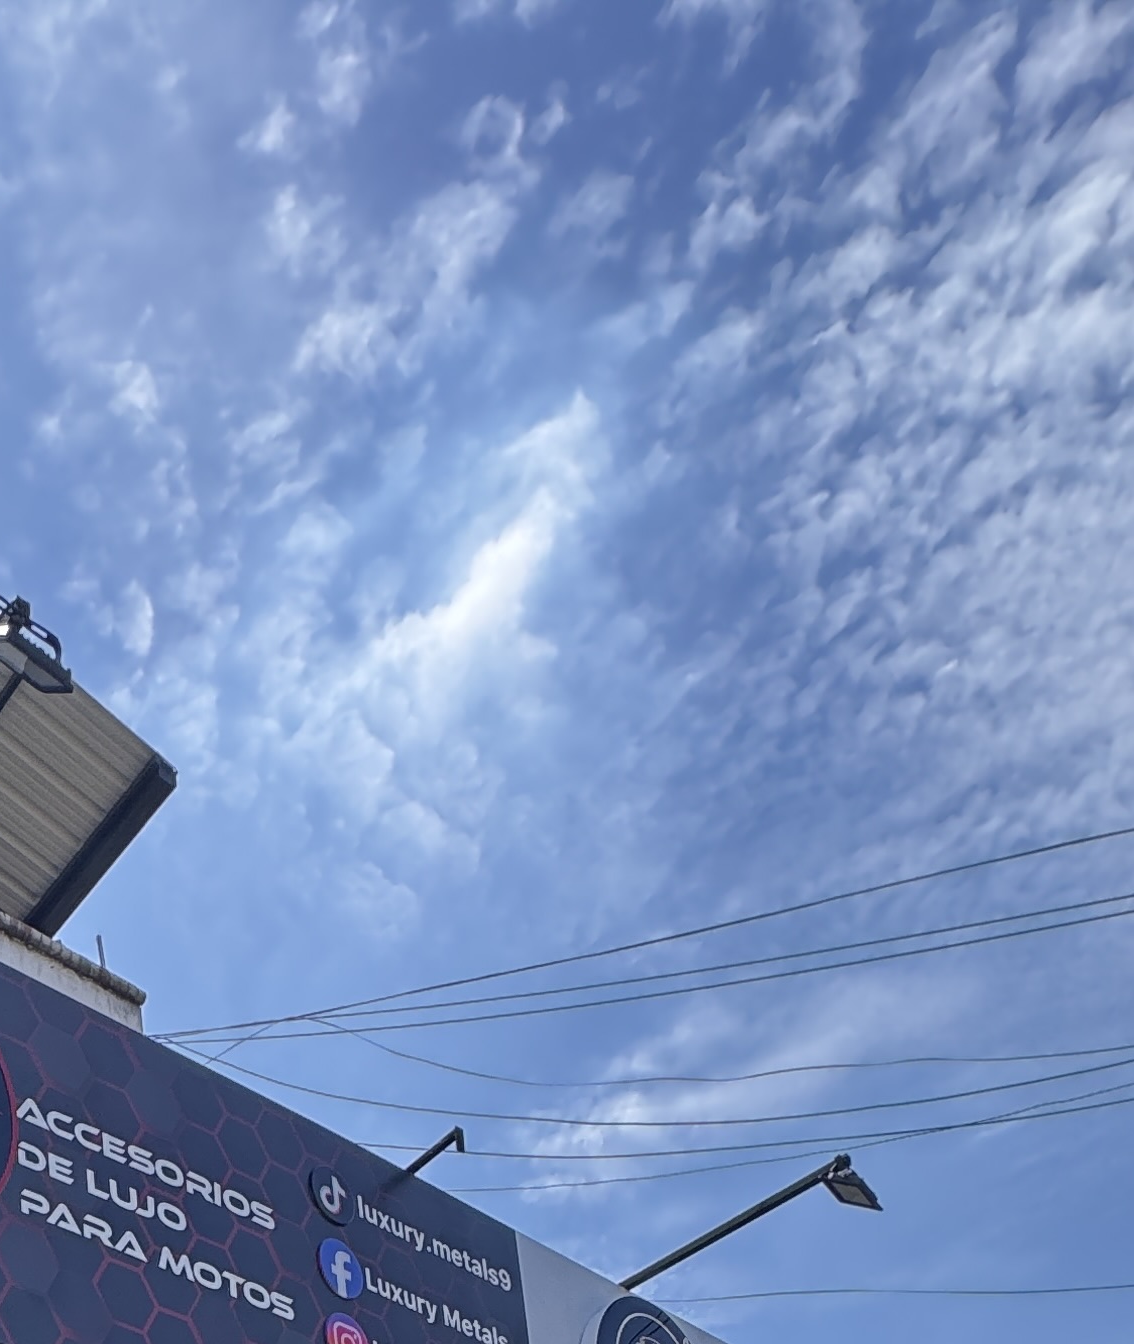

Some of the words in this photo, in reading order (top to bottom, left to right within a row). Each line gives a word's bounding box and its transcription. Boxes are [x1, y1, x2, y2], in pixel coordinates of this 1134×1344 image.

[16, 1098, 275, 1230] ACCESORIOS
[18, 1141, 74, 1185] DE
[86, 1169, 187, 1231] LUJO
[20, 1189, 148, 1262] PARA
[158, 1246, 295, 1321] MOTOS
[356, 1195, 512, 1292] luxury.metals9
[364, 1267, 437, 1324] Luxury
